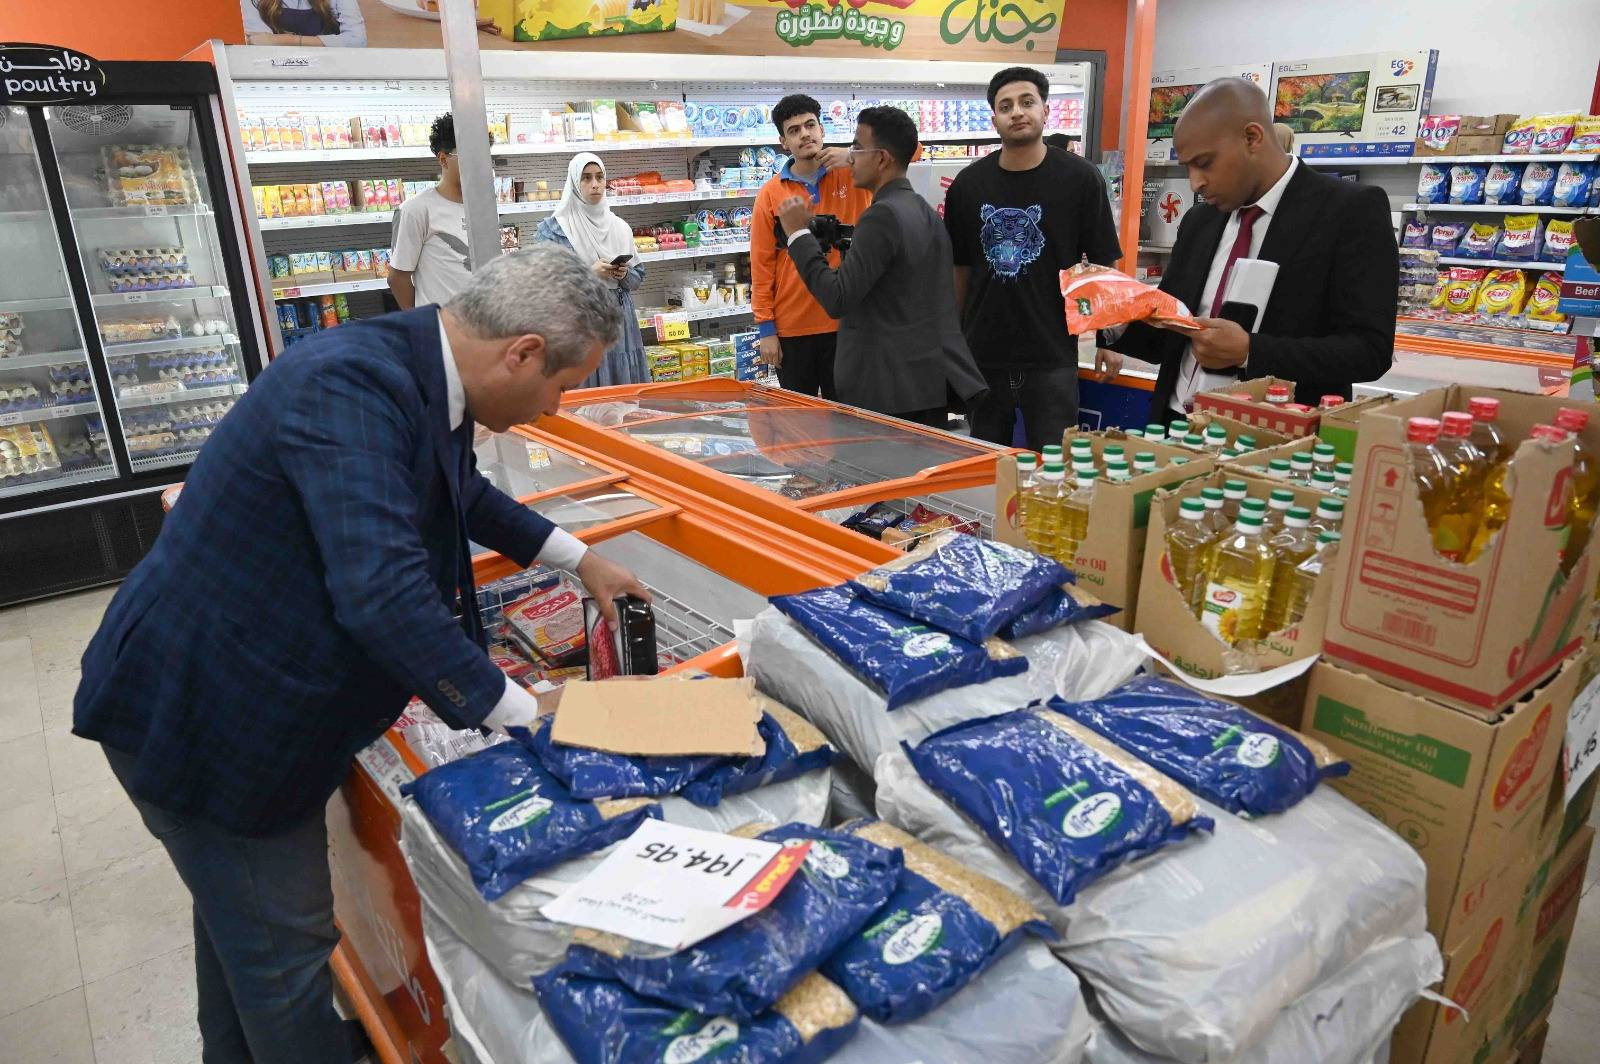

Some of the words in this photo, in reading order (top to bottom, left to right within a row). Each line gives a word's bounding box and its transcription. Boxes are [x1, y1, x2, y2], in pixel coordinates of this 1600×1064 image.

[4, 76, 97, 96] poultry
[1392, 125, 1406, 136] 42
[1503, 229, 1532, 242] Persil
[1574, 285, 1600, 297] Beef
[636, 842, 744, 877] 194.95
